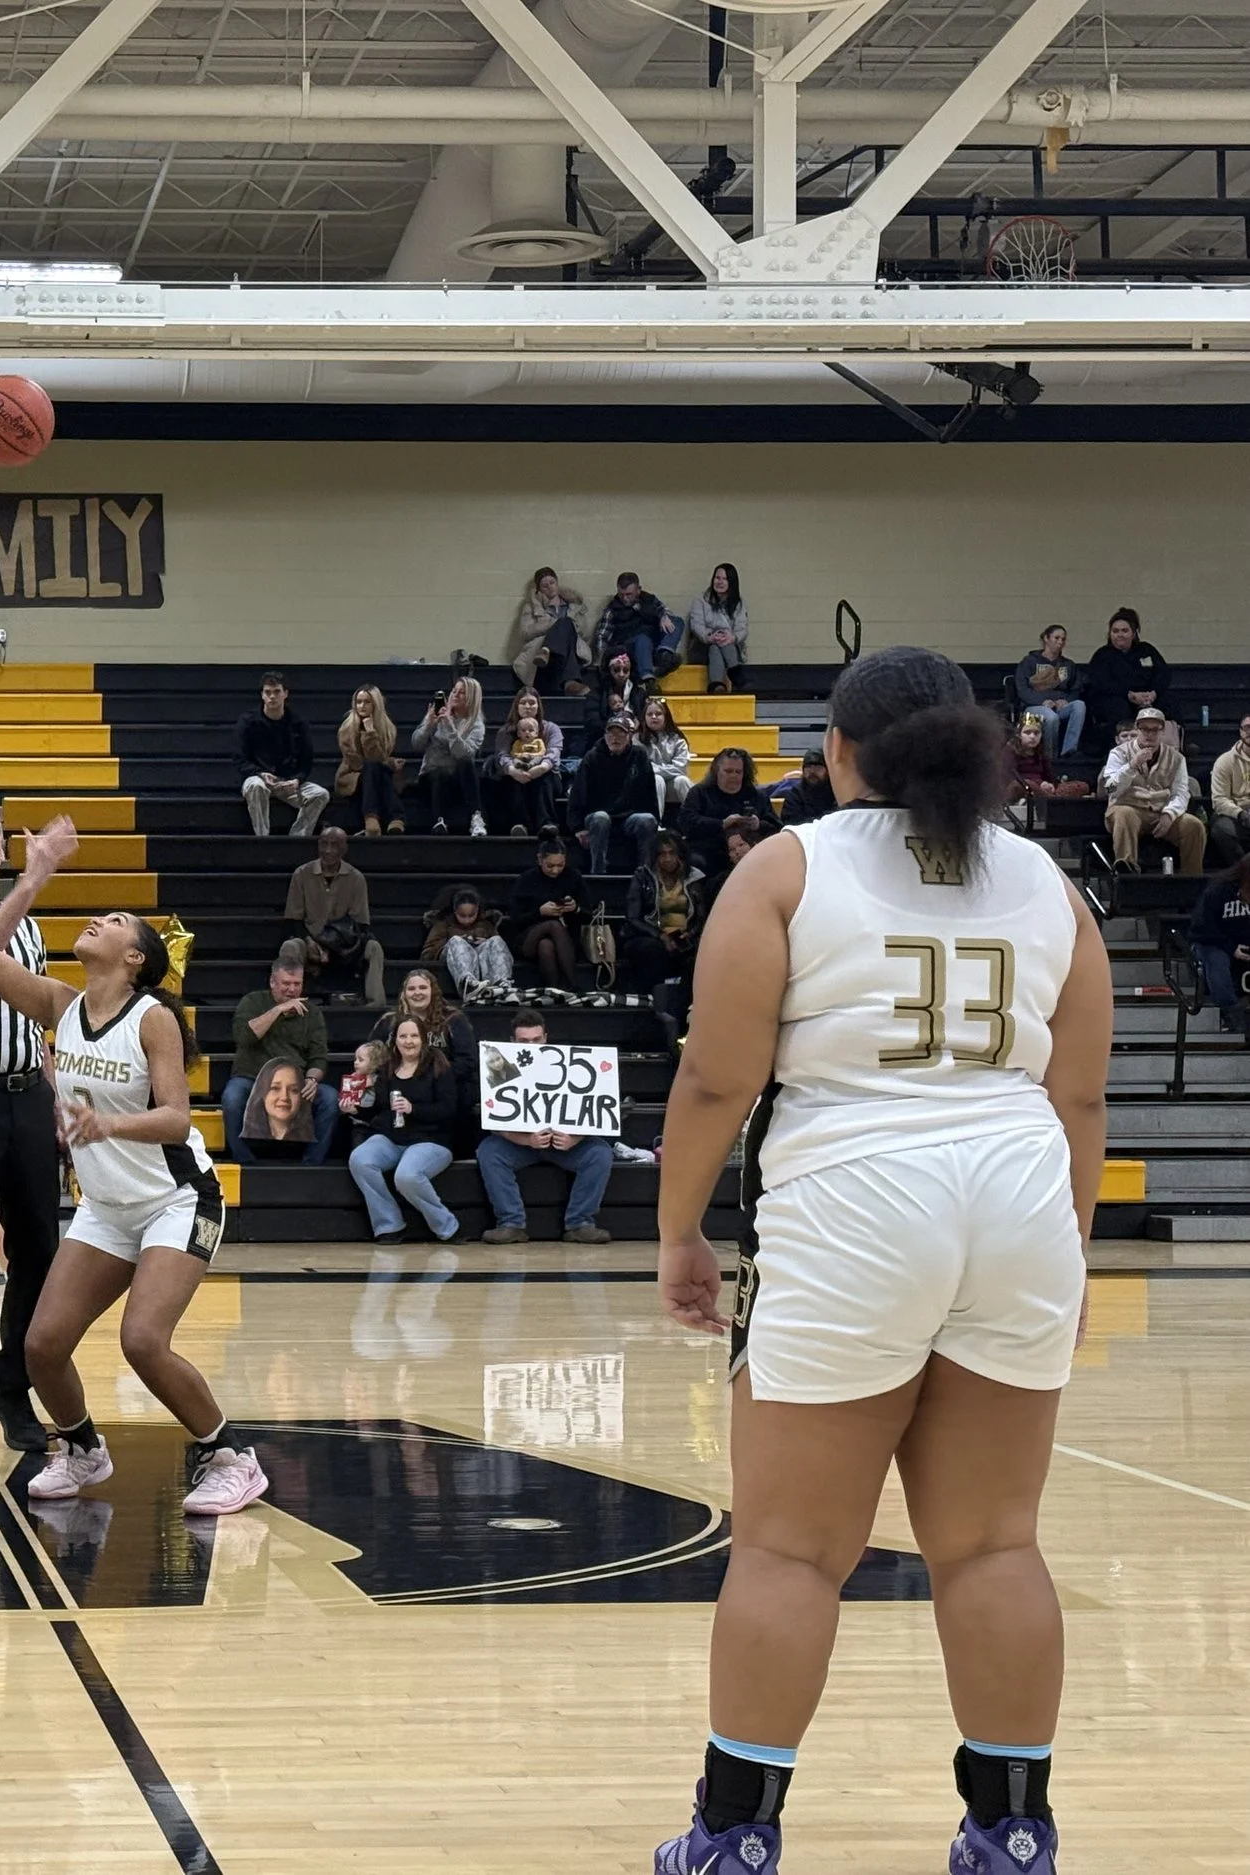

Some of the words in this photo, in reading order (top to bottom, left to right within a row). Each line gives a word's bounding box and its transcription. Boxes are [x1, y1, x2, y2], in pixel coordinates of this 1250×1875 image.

[905, 836, 964, 885] W
[878, 935, 1016, 1069] 33
[488, 1086, 620, 1131] SKYLAR
[195, 1214, 221, 1252] W
